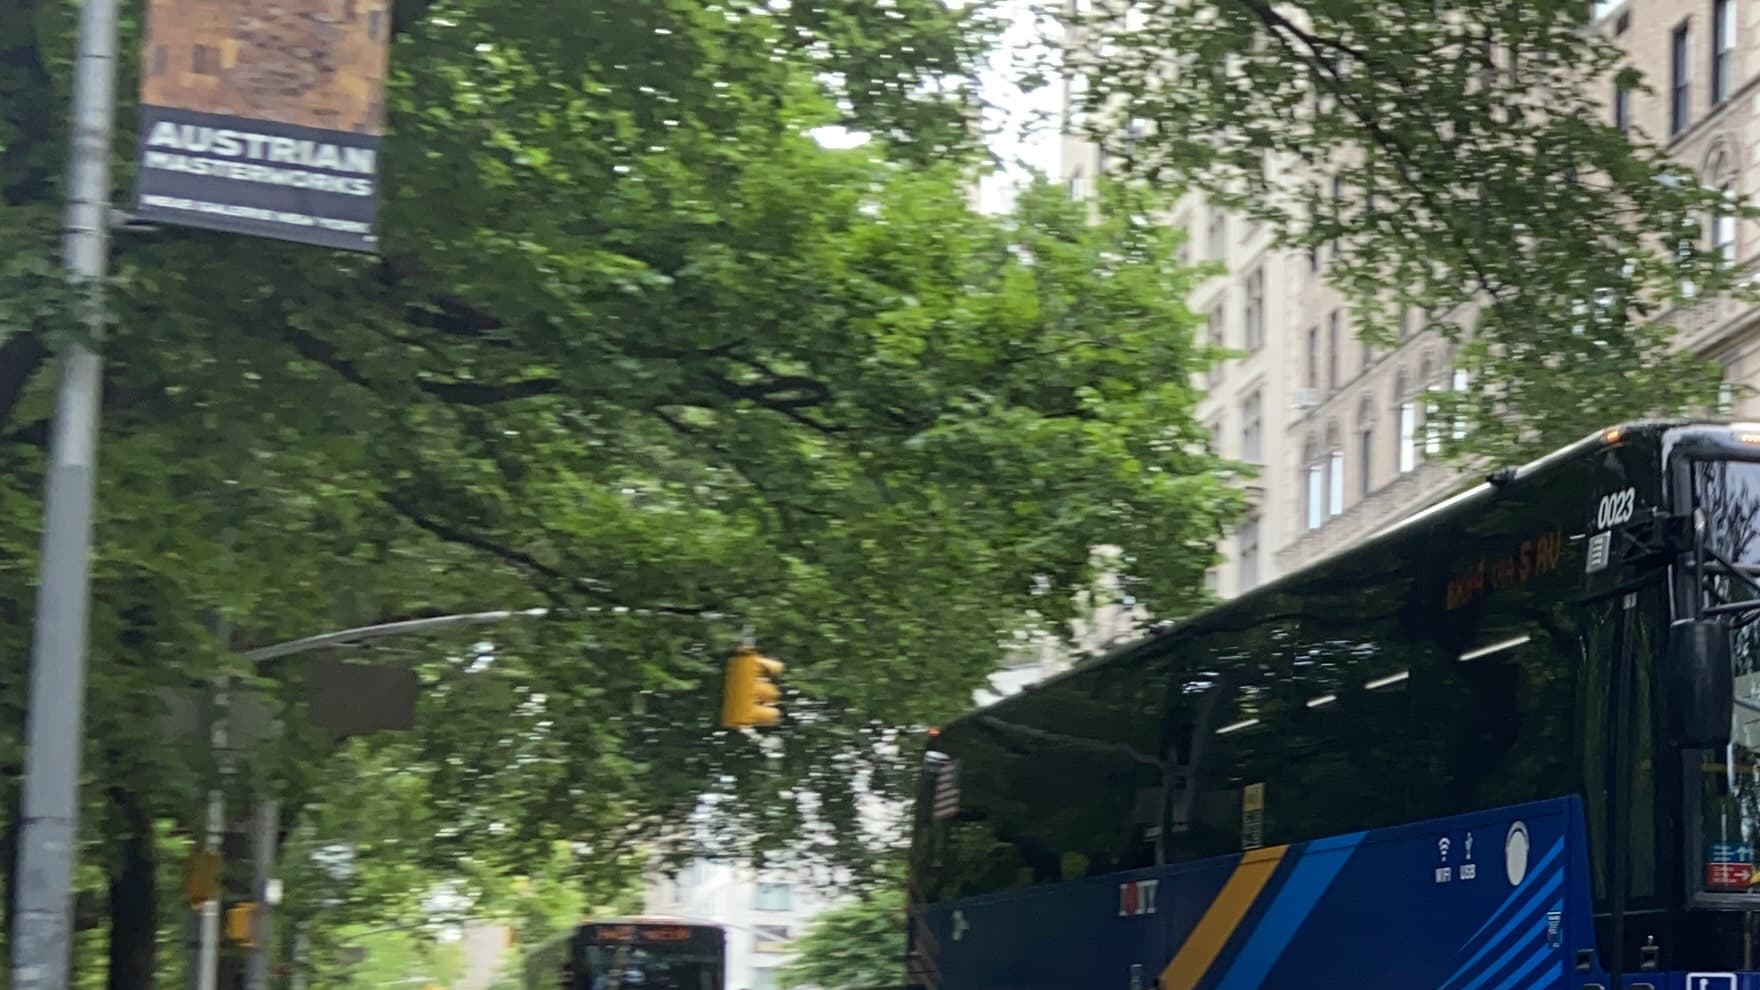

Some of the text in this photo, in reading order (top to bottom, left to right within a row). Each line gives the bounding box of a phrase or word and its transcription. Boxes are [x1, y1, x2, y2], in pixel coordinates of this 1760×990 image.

[146, 121, 376, 174] AUSTRIAN
[1597, 487, 1636, 529] 0023
[1459, 863, 1476, 880] USB
